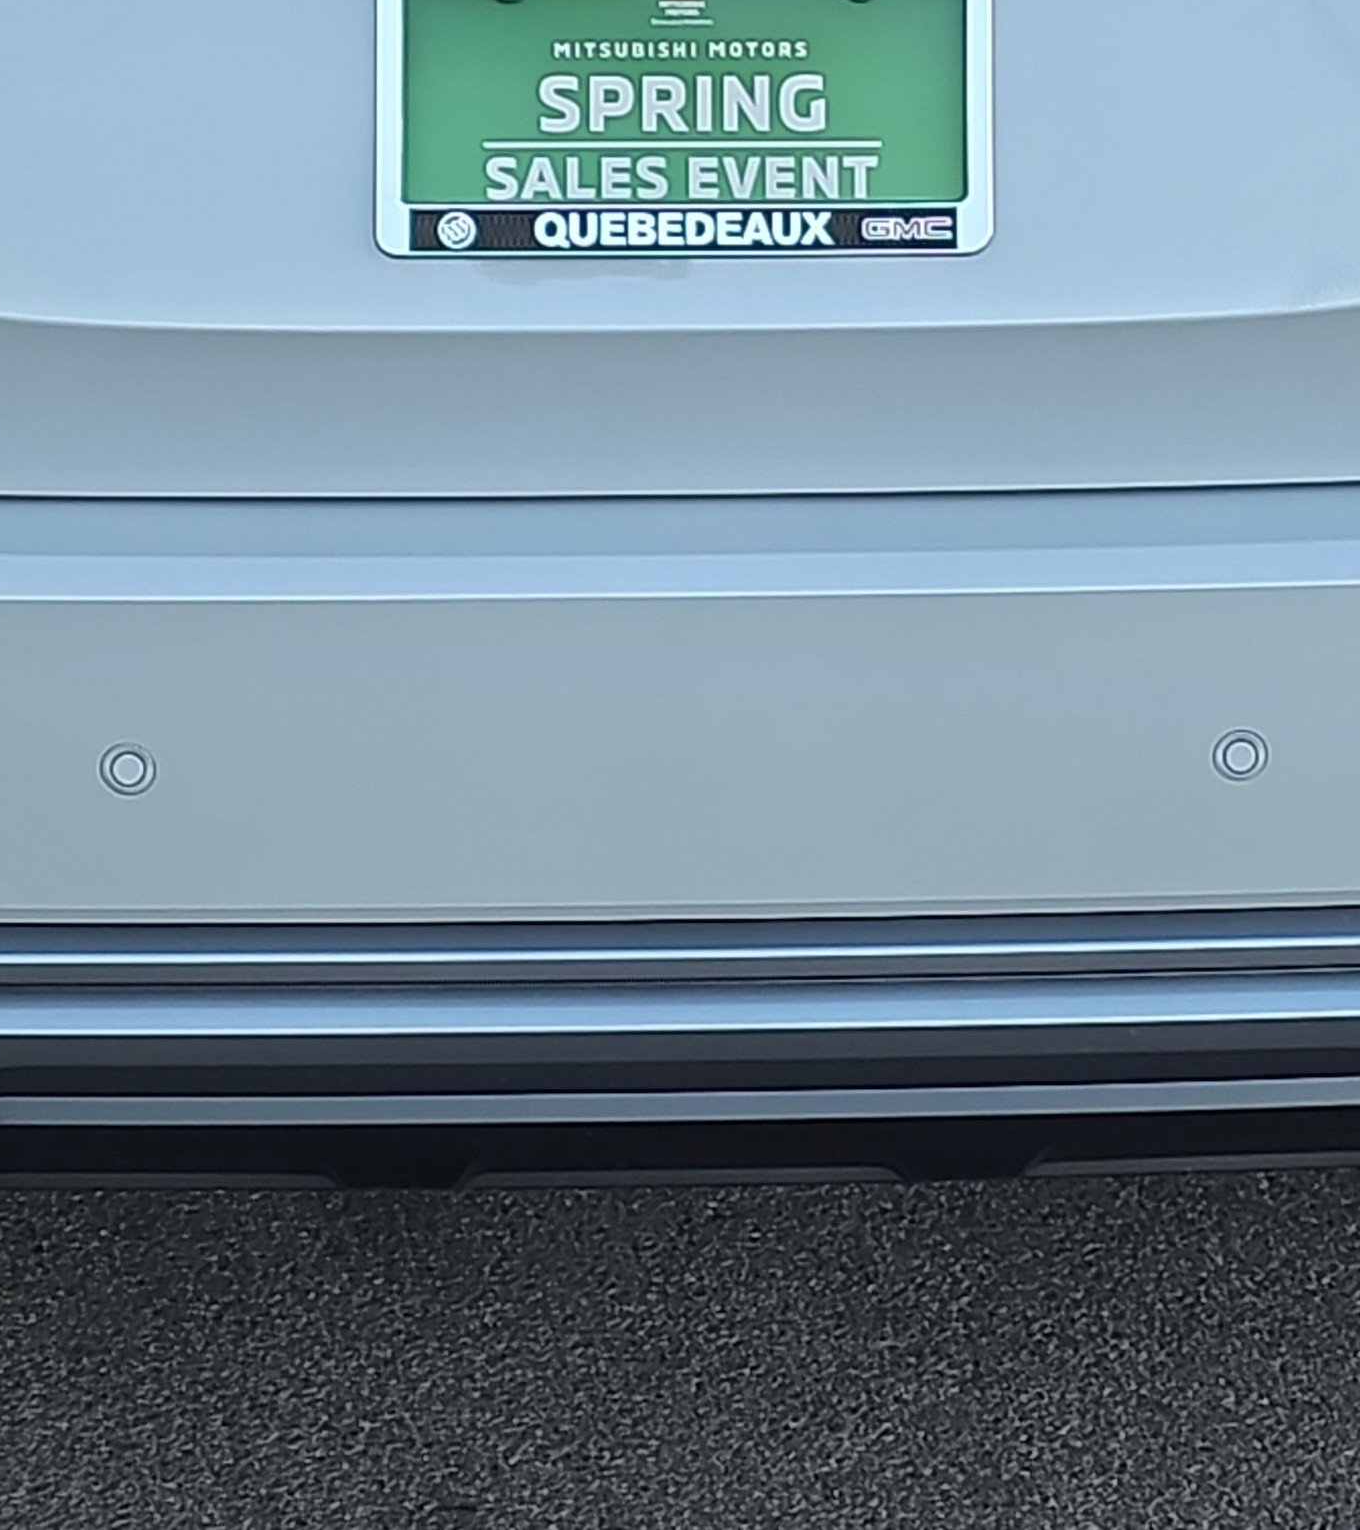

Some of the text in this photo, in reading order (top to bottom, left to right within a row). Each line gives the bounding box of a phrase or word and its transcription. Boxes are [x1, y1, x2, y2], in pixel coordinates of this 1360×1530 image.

[552, 41, 809, 59] MITSUBISHI MOTORS
[538, 73, 827, 133] SPRING
[484, 154, 879, 201] SALES EVENT
[533, 210, 954, 249] QUEBEDEAUX GMC
